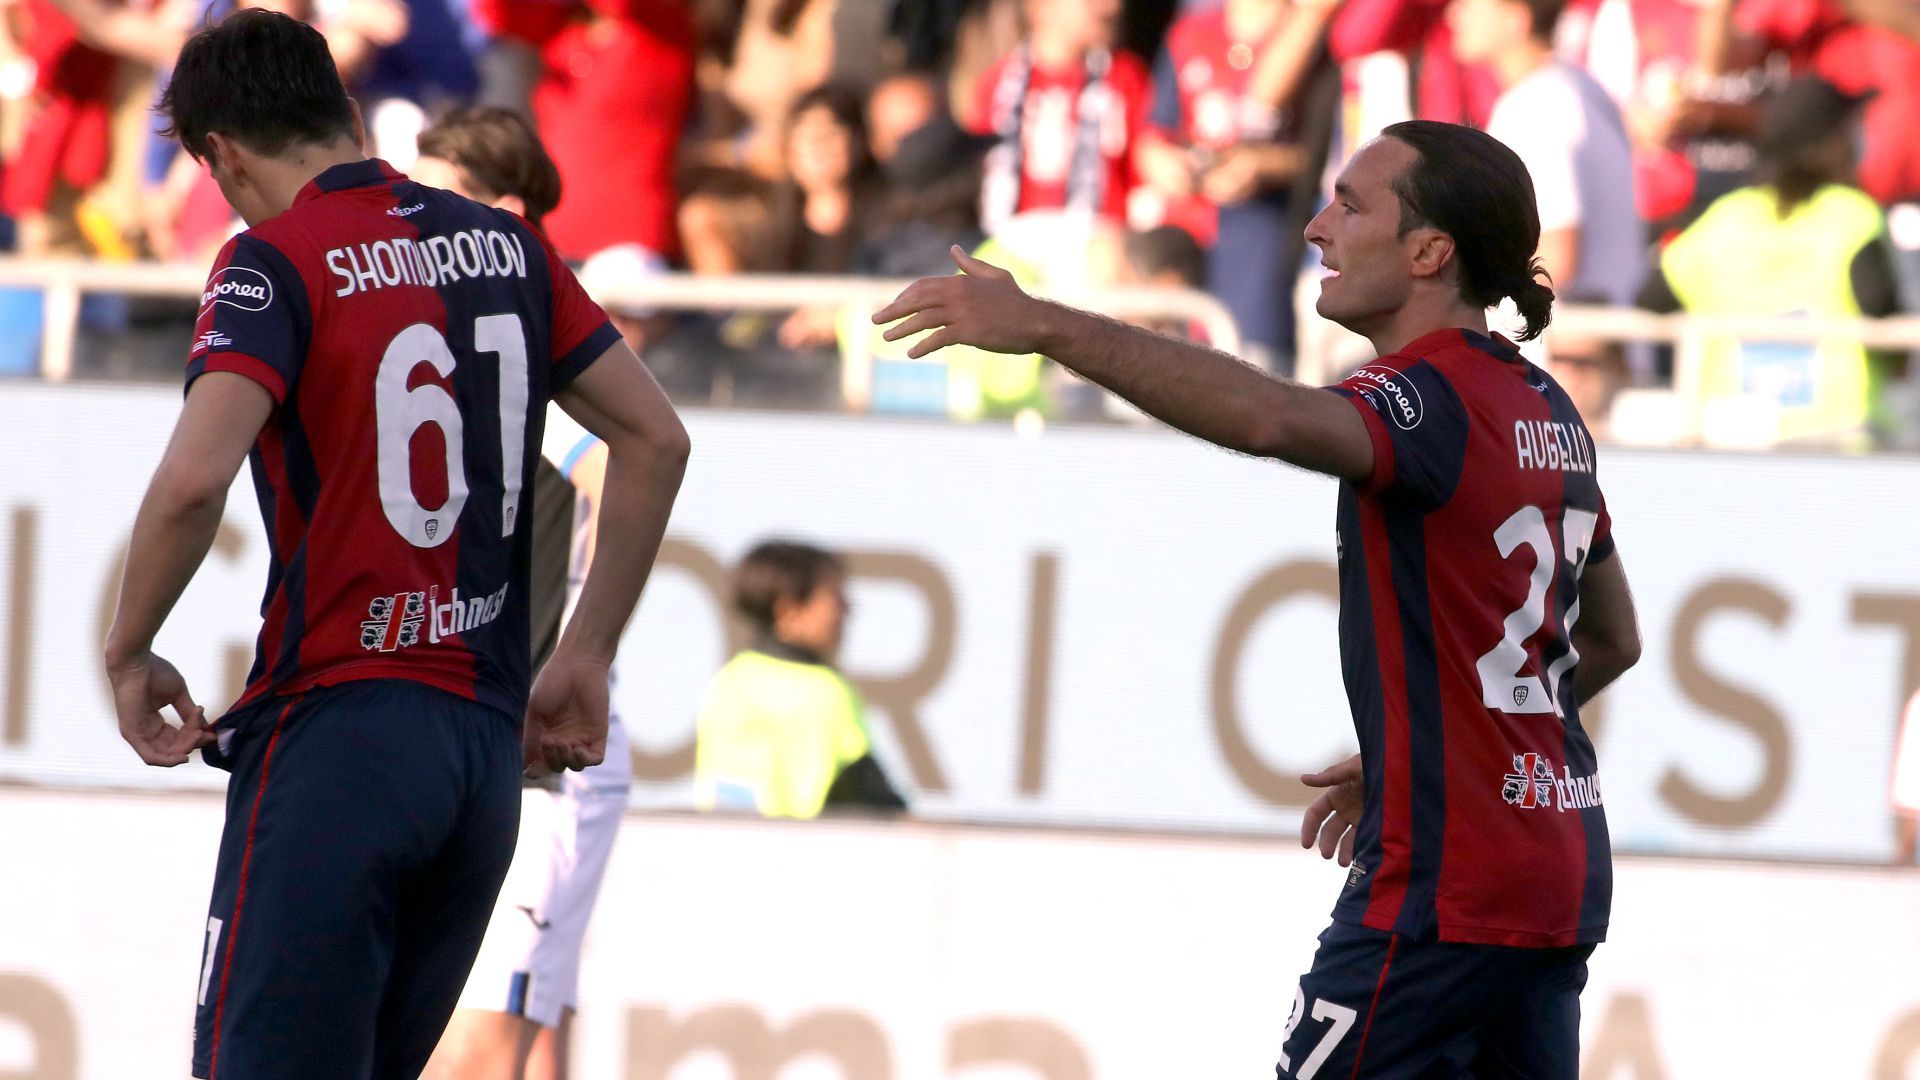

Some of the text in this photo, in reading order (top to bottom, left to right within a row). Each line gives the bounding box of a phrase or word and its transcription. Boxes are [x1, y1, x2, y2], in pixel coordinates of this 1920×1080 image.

[325, 229, 527, 298] SHOMURODOV
[1352, 369, 1416, 423] arborea
[375, 313, 529, 549] 61
[1514, 419, 1592, 475] AUGELLO
[1475, 505, 1598, 718] 27
[1545, 758, 1603, 813] ichnus
